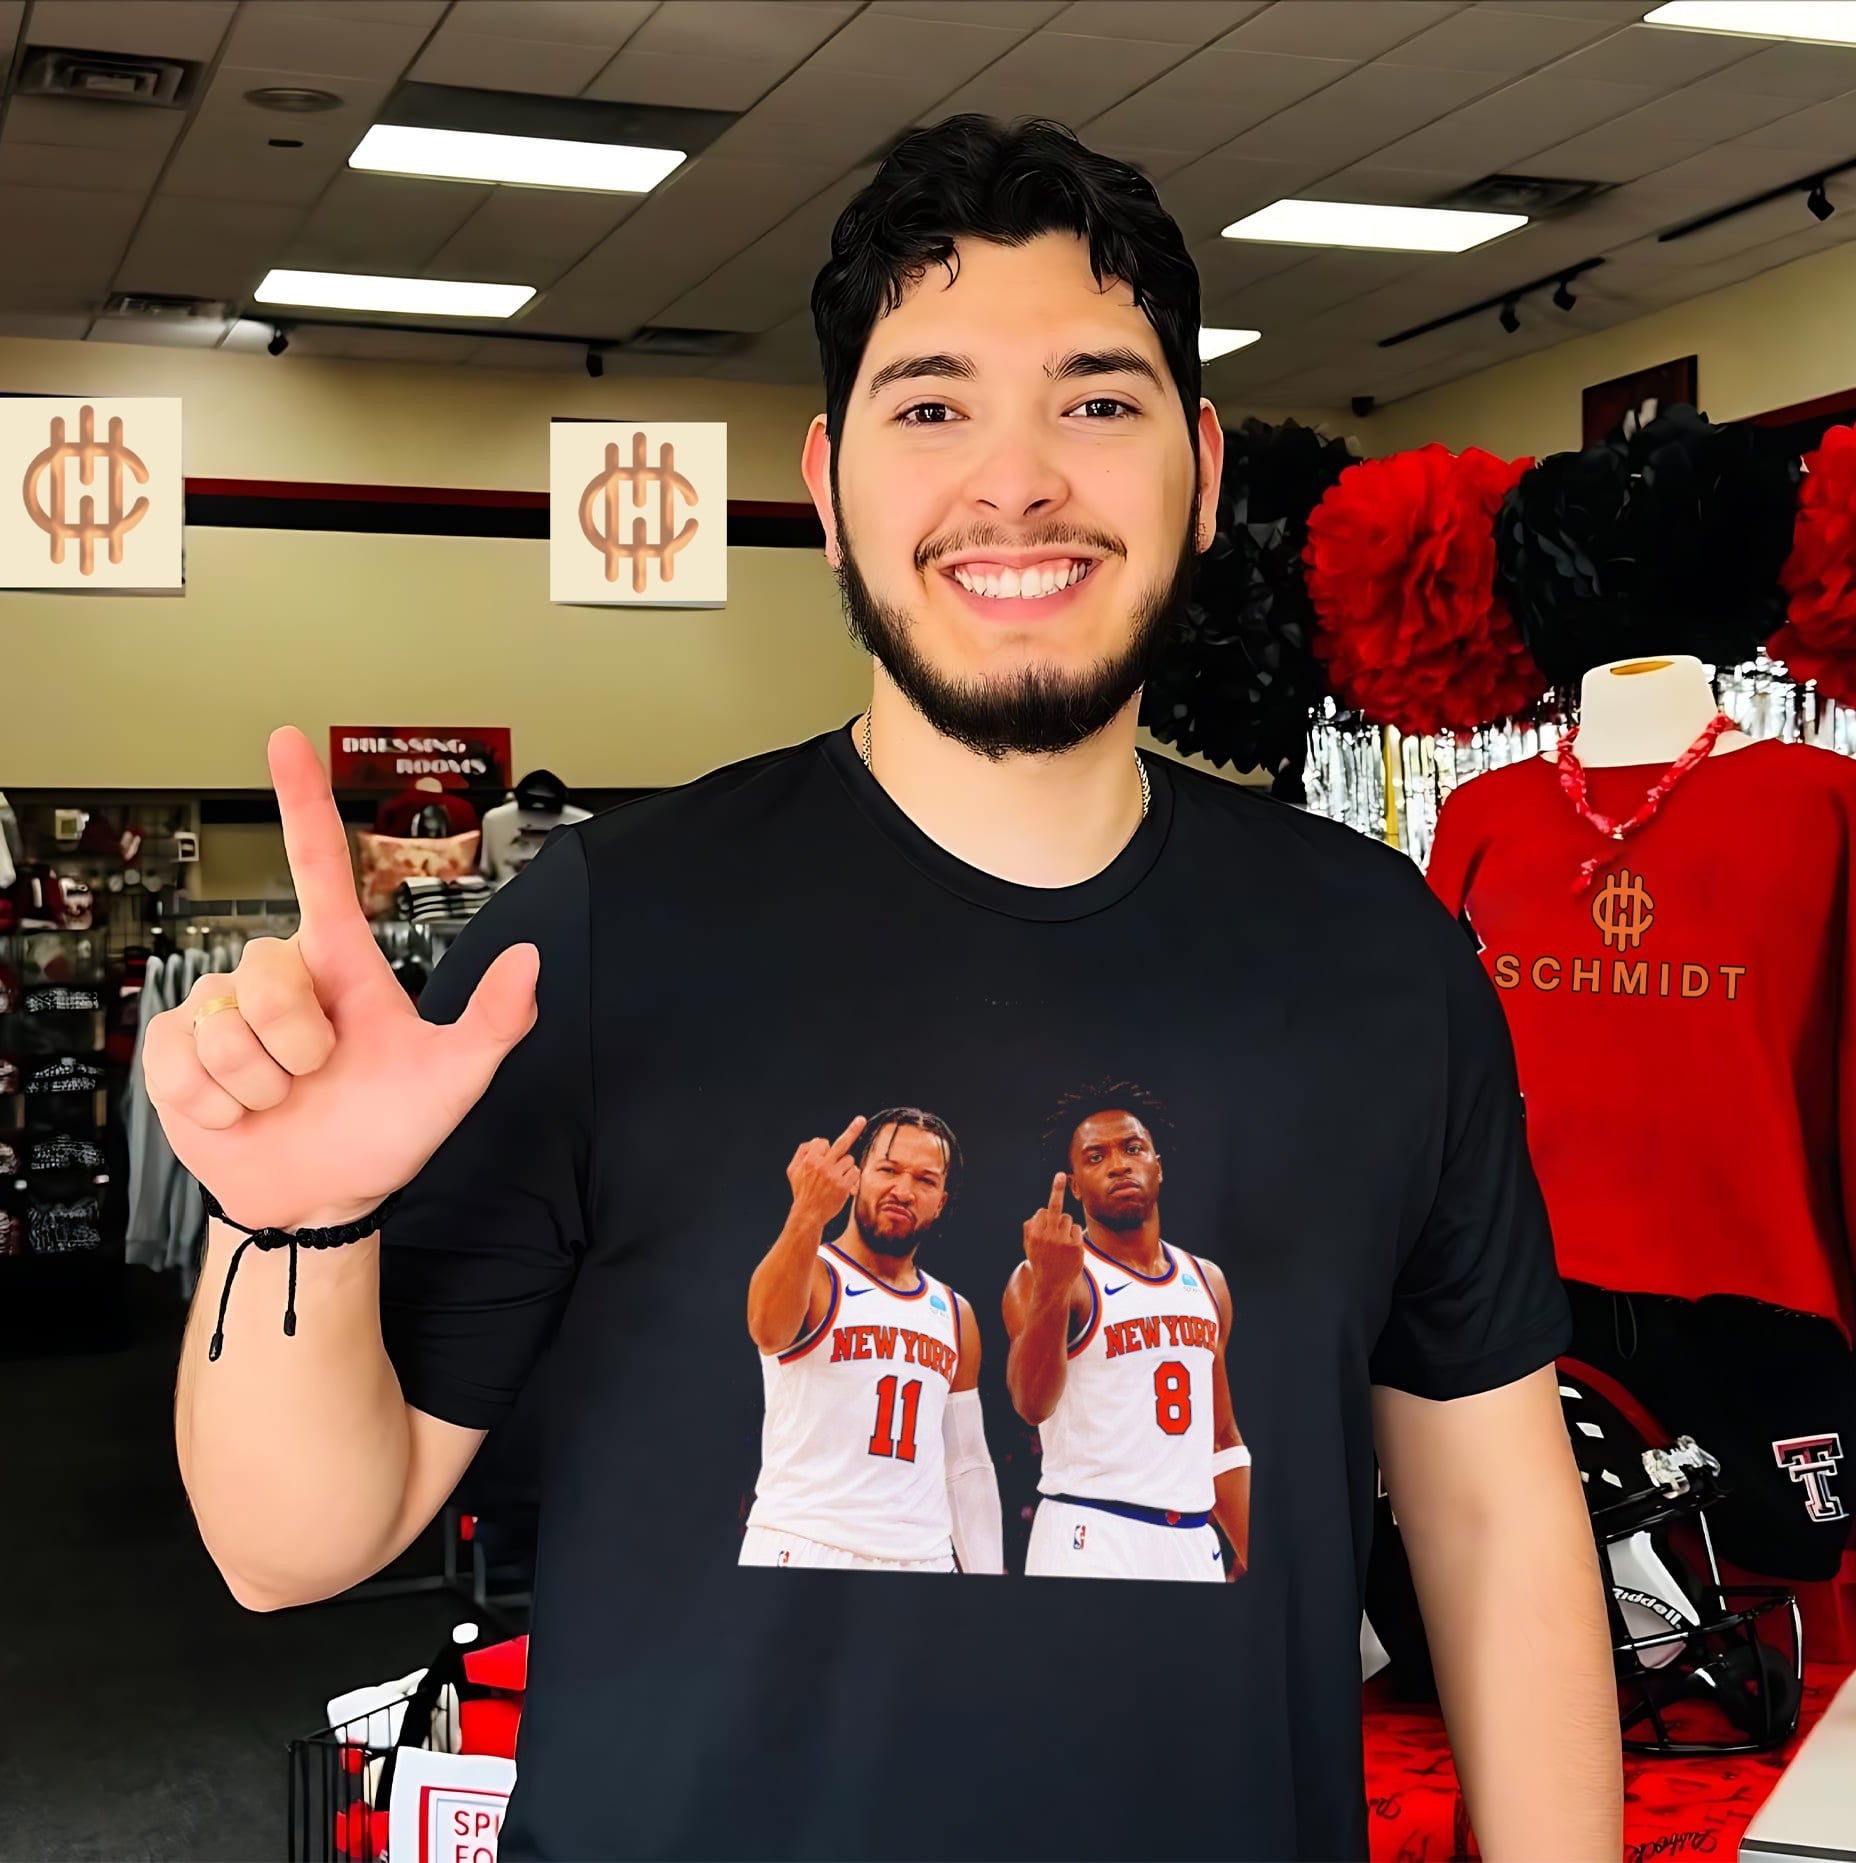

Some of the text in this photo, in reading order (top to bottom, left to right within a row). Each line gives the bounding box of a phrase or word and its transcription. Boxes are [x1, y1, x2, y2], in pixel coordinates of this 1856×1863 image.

[396, 758, 487, 775] ROOMS
[1494, 954, 1747, 1000] SCHMIDT
[830, 1325, 958, 1381] NEW YORK
[1103, 1315, 1217, 1359] NEW YORK
[868, 1374, 923, 1463] 11
[1153, 1361, 1192, 1435] 8
